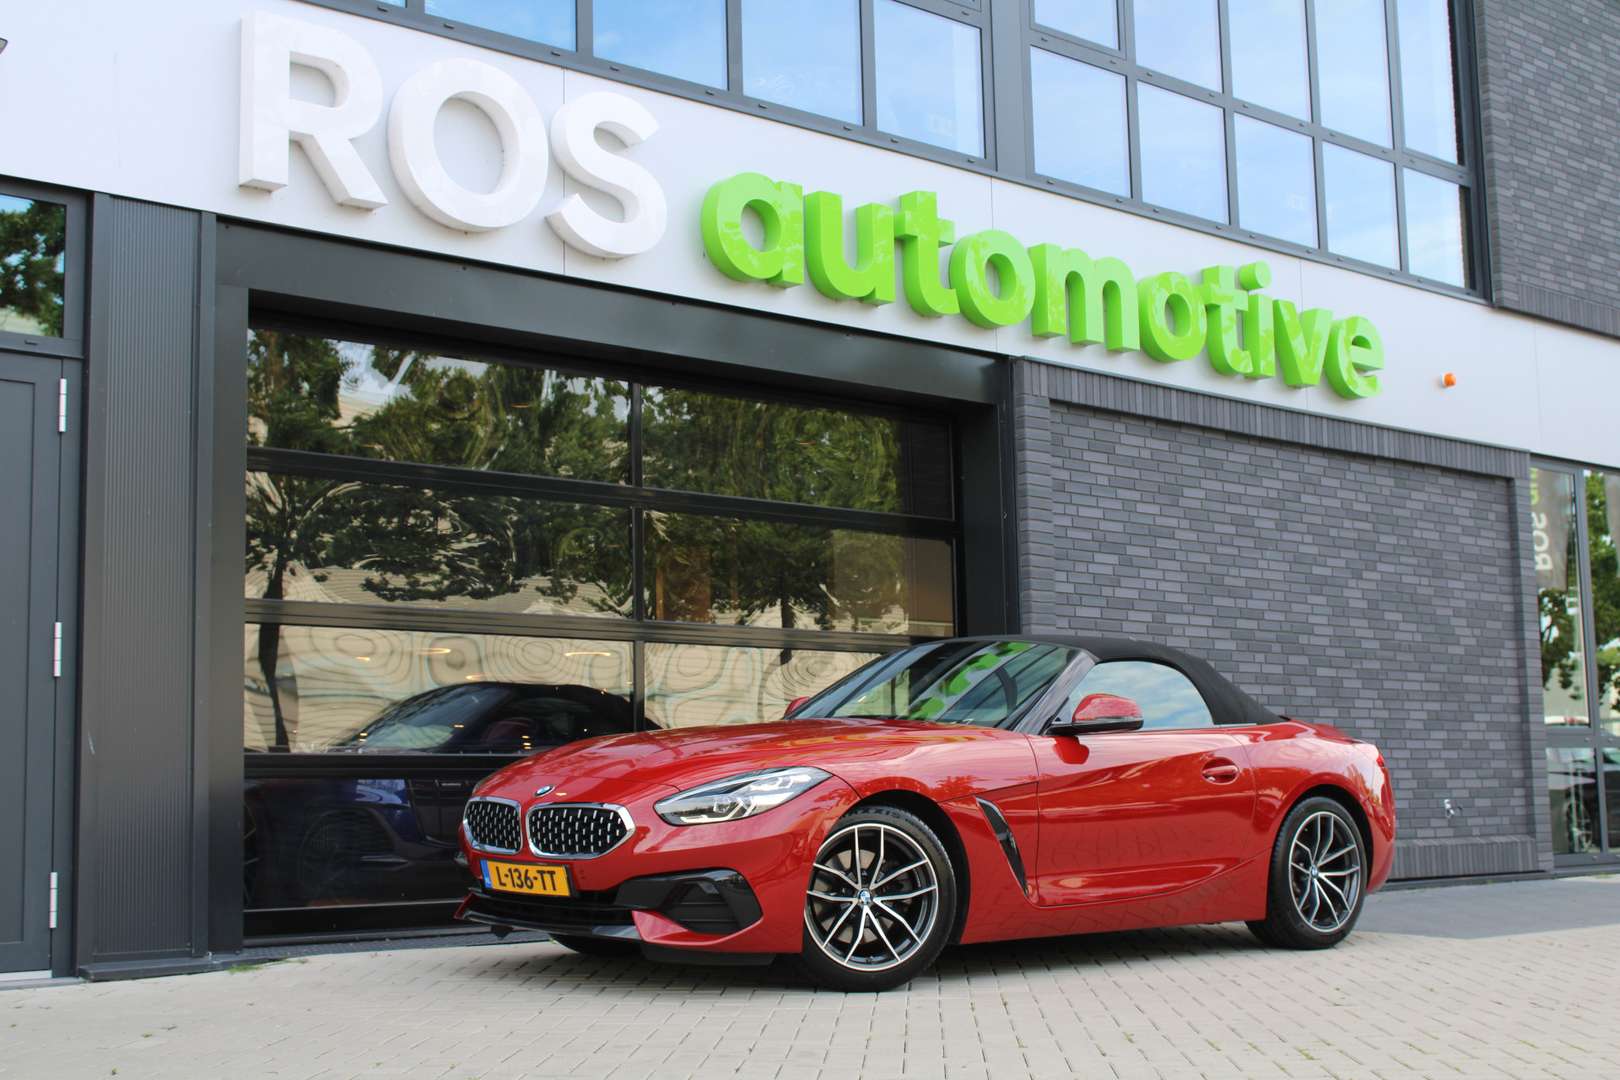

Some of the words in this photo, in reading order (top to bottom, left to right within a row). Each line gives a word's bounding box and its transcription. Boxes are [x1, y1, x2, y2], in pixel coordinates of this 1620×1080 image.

[240, 12, 667, 258] ROS
[700, 172, 1383, 399] automotive
[496, 866, 557, 891] L-136-TT
